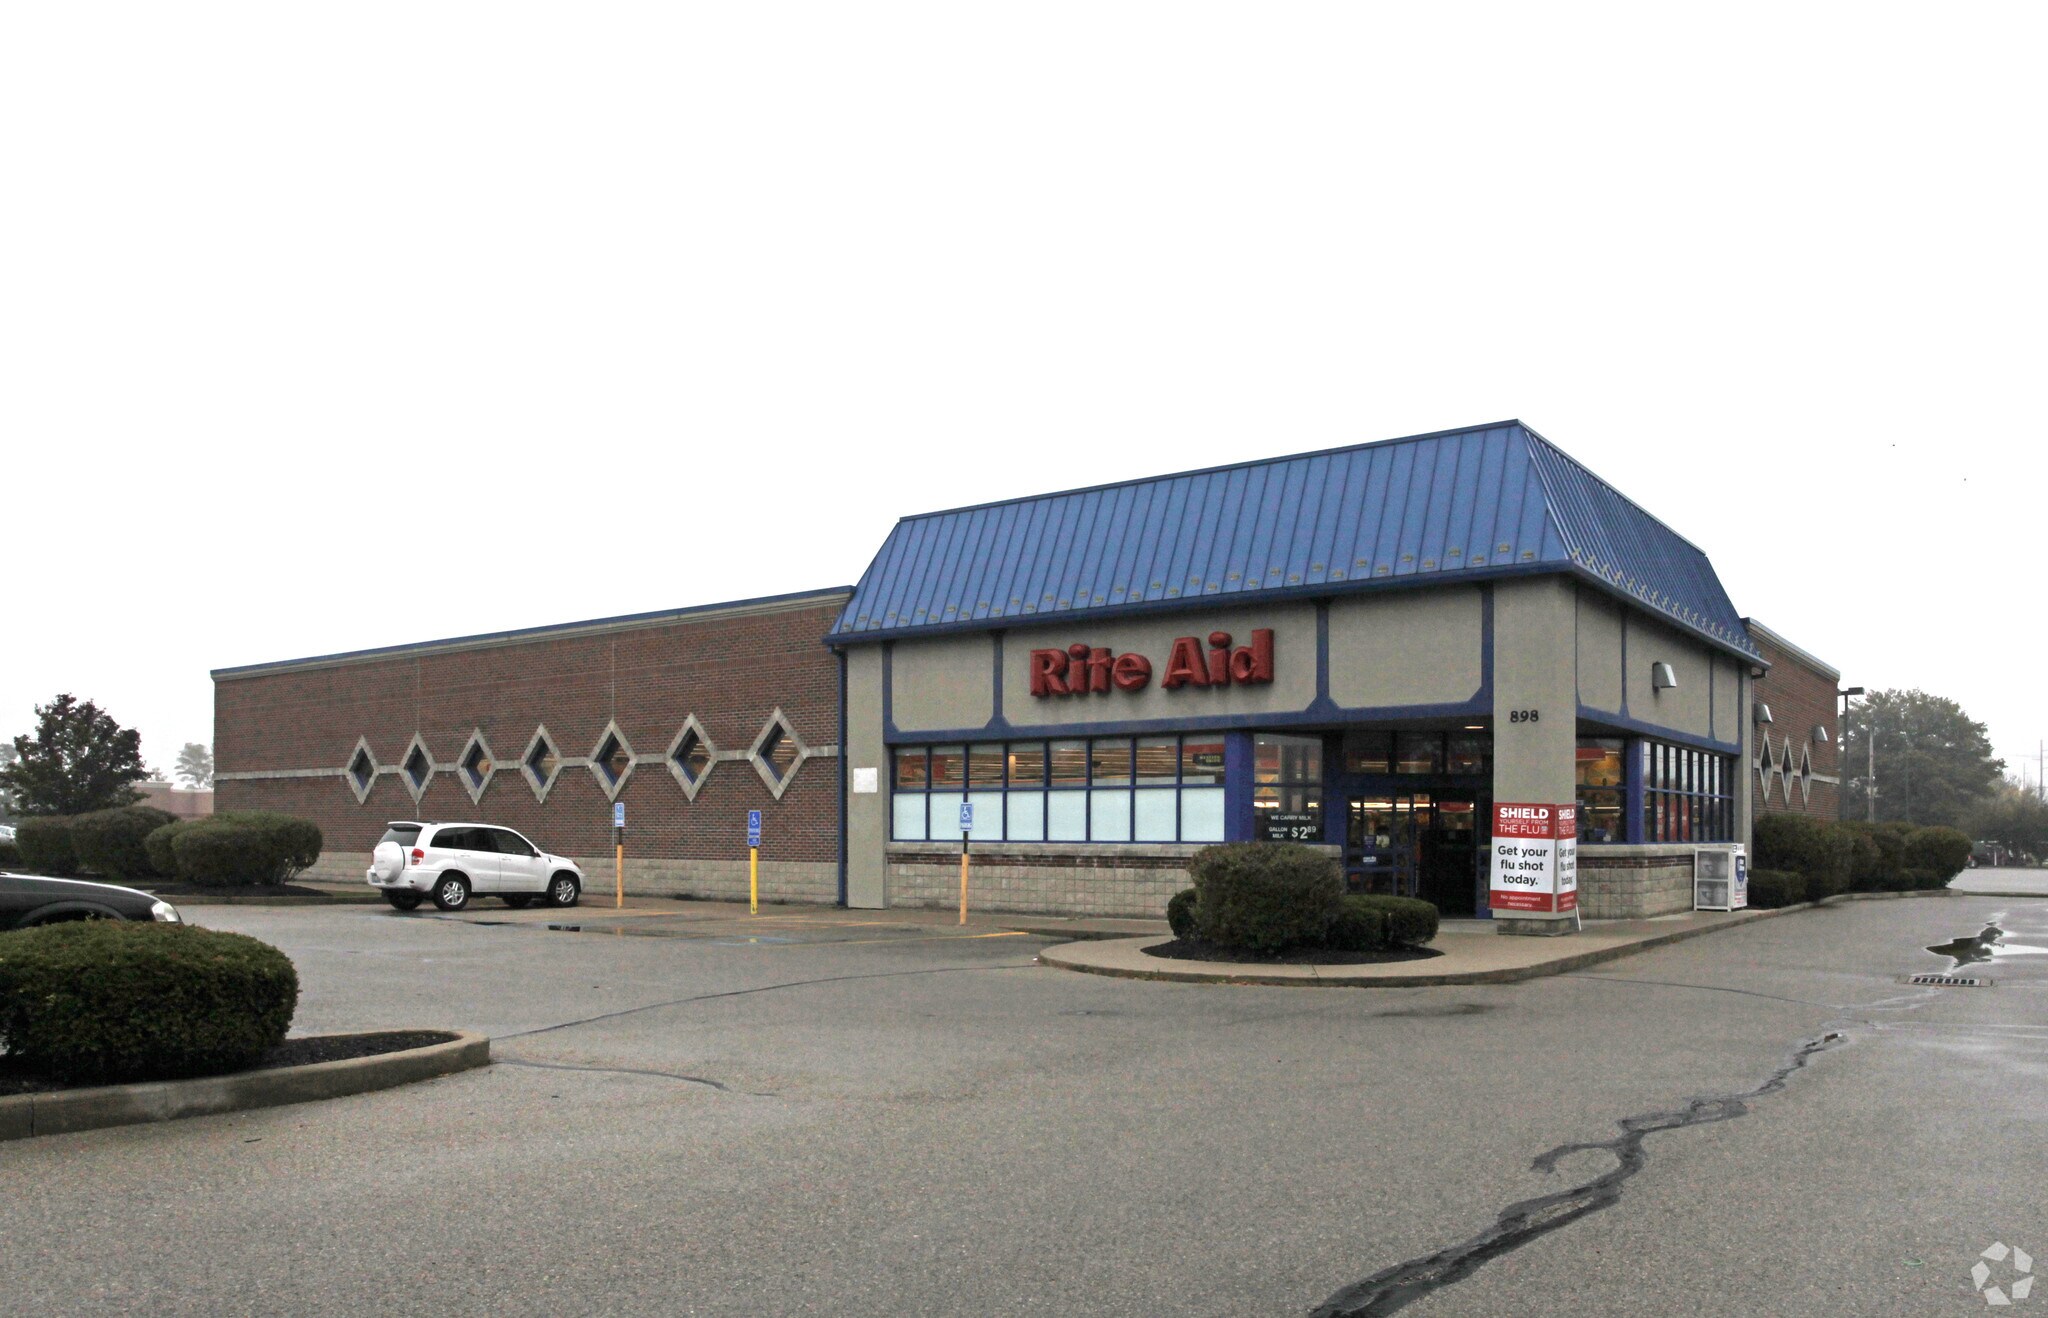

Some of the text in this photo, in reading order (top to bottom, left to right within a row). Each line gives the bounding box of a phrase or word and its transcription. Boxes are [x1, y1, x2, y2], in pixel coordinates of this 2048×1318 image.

[1030, 628, 1274, 697] Rite Aid
[1510, 709, 1539, 723] 898
[1499, 807, 1549, 819] SHIELD
[1558, 808, 1575, 820] SHIELD
[1499, 824, 1540, 834] THE FLU
[1498, 845, 1548, 858] Get your
[1500, 859, 1544, 871] flu shot
[1503, 874, 1538, 886] today.
